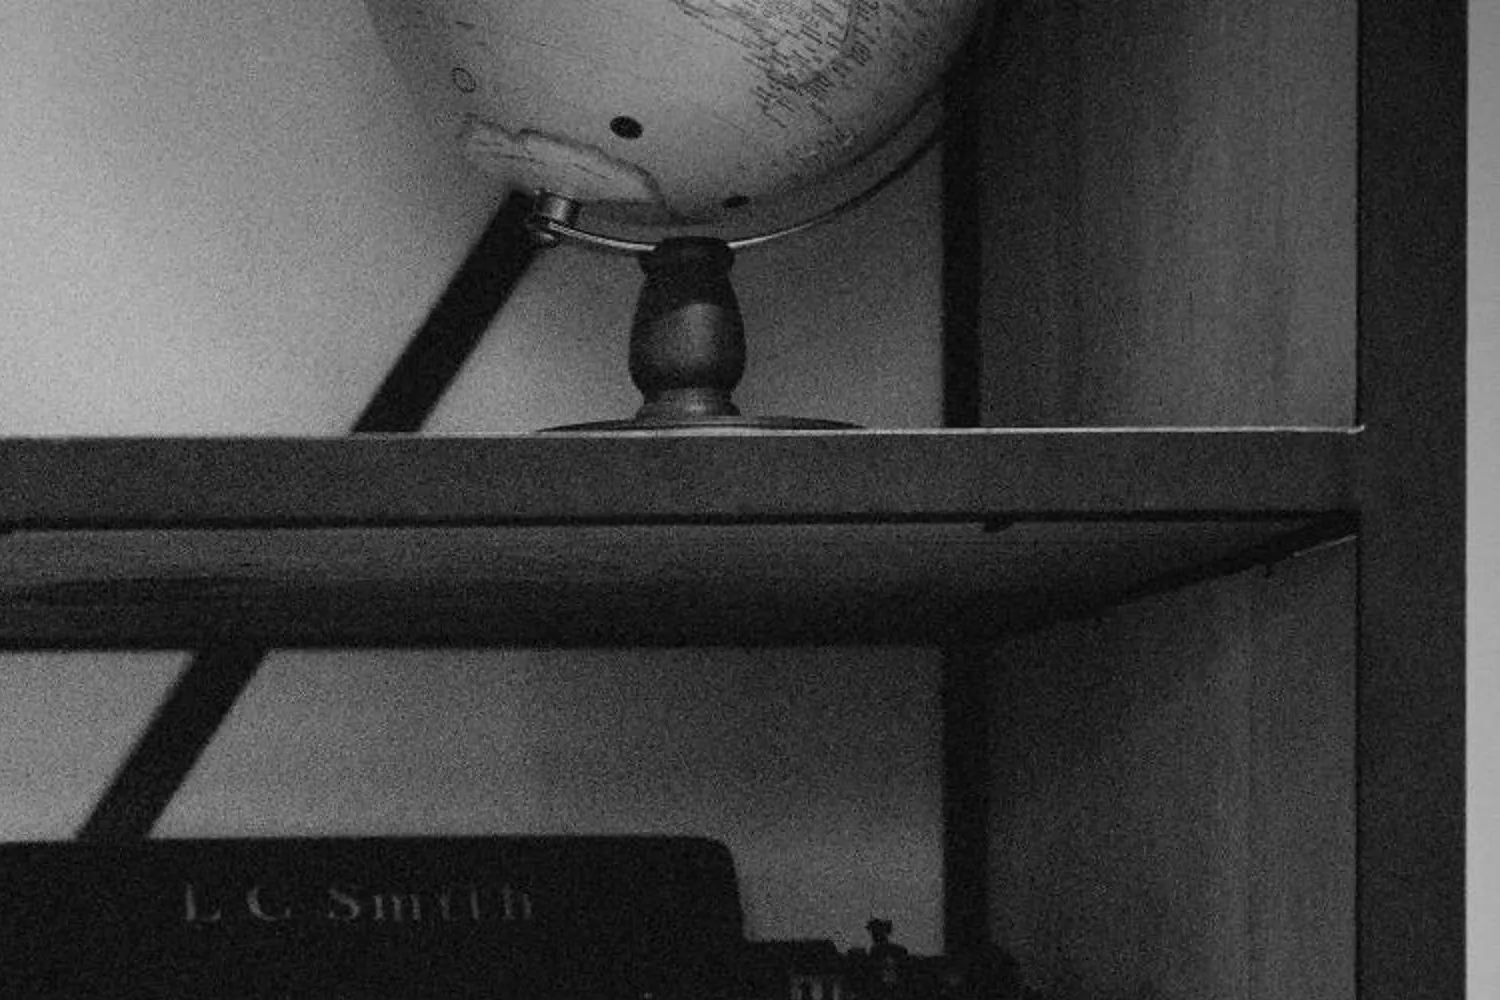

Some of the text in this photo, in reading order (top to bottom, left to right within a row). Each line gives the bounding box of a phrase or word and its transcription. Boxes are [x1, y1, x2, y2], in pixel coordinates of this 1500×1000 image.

[182, 879, 535, 924] L C Smith
